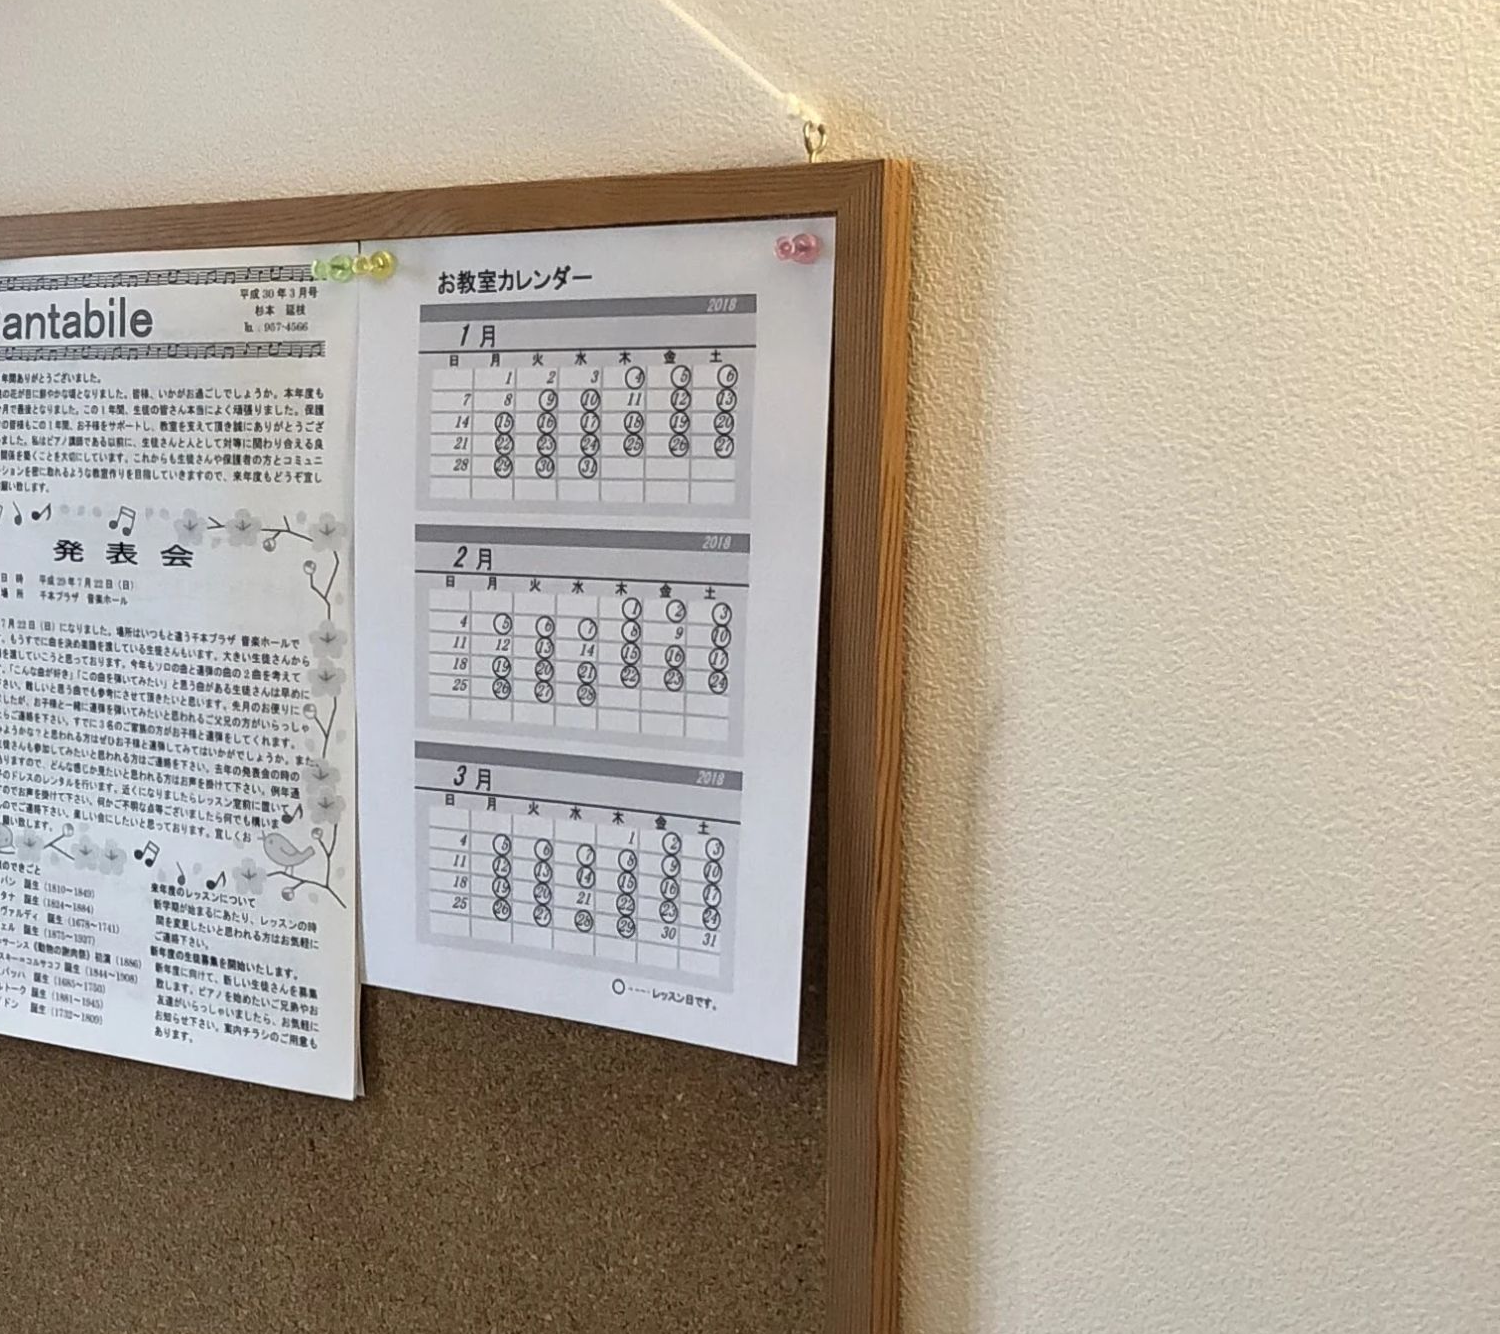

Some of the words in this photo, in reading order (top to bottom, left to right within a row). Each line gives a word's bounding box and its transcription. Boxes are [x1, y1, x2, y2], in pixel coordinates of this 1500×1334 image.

[438, 265, 592, 295] お教室カレンダー
[707, 297, 737, 312] 2018
[448, 355, 459, 367] 日
[490, 352, 501, 367] 月
[532, 352, 544, 366] 火
[574, 351, 588, 365] 水
[619, 351, 632, 364] 木
[663, 350, 677, 364] 金
[709, 350, 722, 363] 土
[505, 371, 512, 385] 1
[546, 371, 555, 385] 2
[590, 370, 599, 384] 3
[462, 393, 471, 407] 7
[503, 393, 512, 407] 8
[627, 392, 641, 407] 11
[455, 415, 470, 429] 14
[453, 437, 468, 451] 21
[453, 458, 468, 473] 28
[53, 539, 194, 567] 発表会
[453, 546, 493, 571] 2月
[453, 765, 492, 791] 3月
